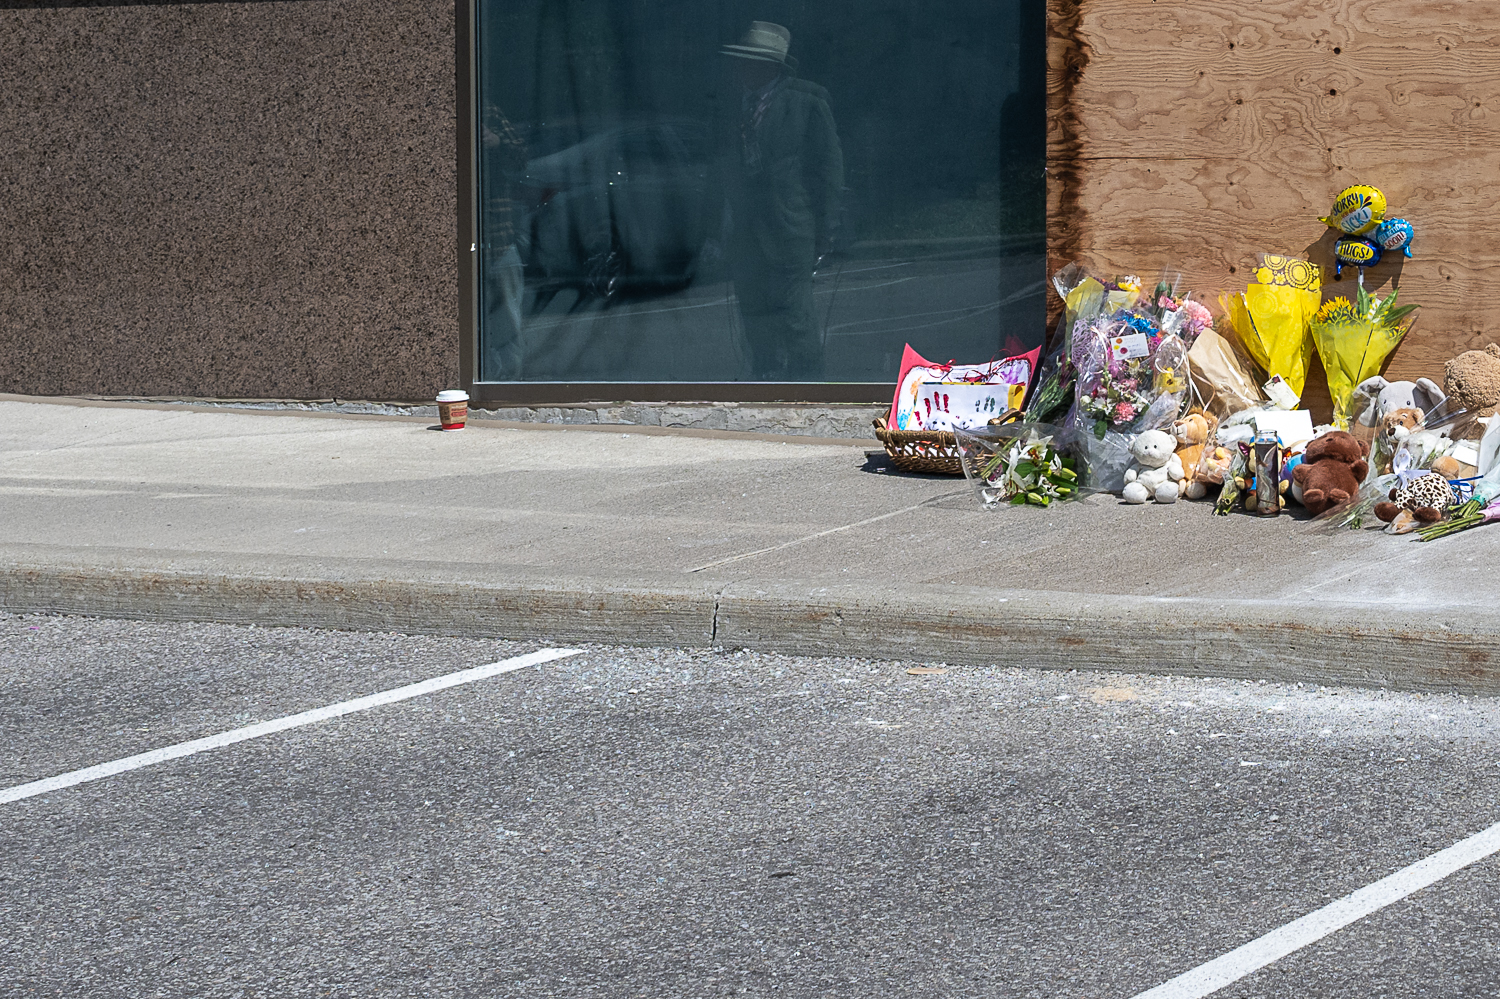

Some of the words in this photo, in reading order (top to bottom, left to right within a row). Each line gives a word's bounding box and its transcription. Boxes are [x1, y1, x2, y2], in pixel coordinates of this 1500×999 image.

[1333, 192, 1359, 216] SORRY
[1341, 209, 1371, 233] SICK!
[1384, 231, 1406, 249] SOON!
[1340, 243, 1370, 259] HUGS!
